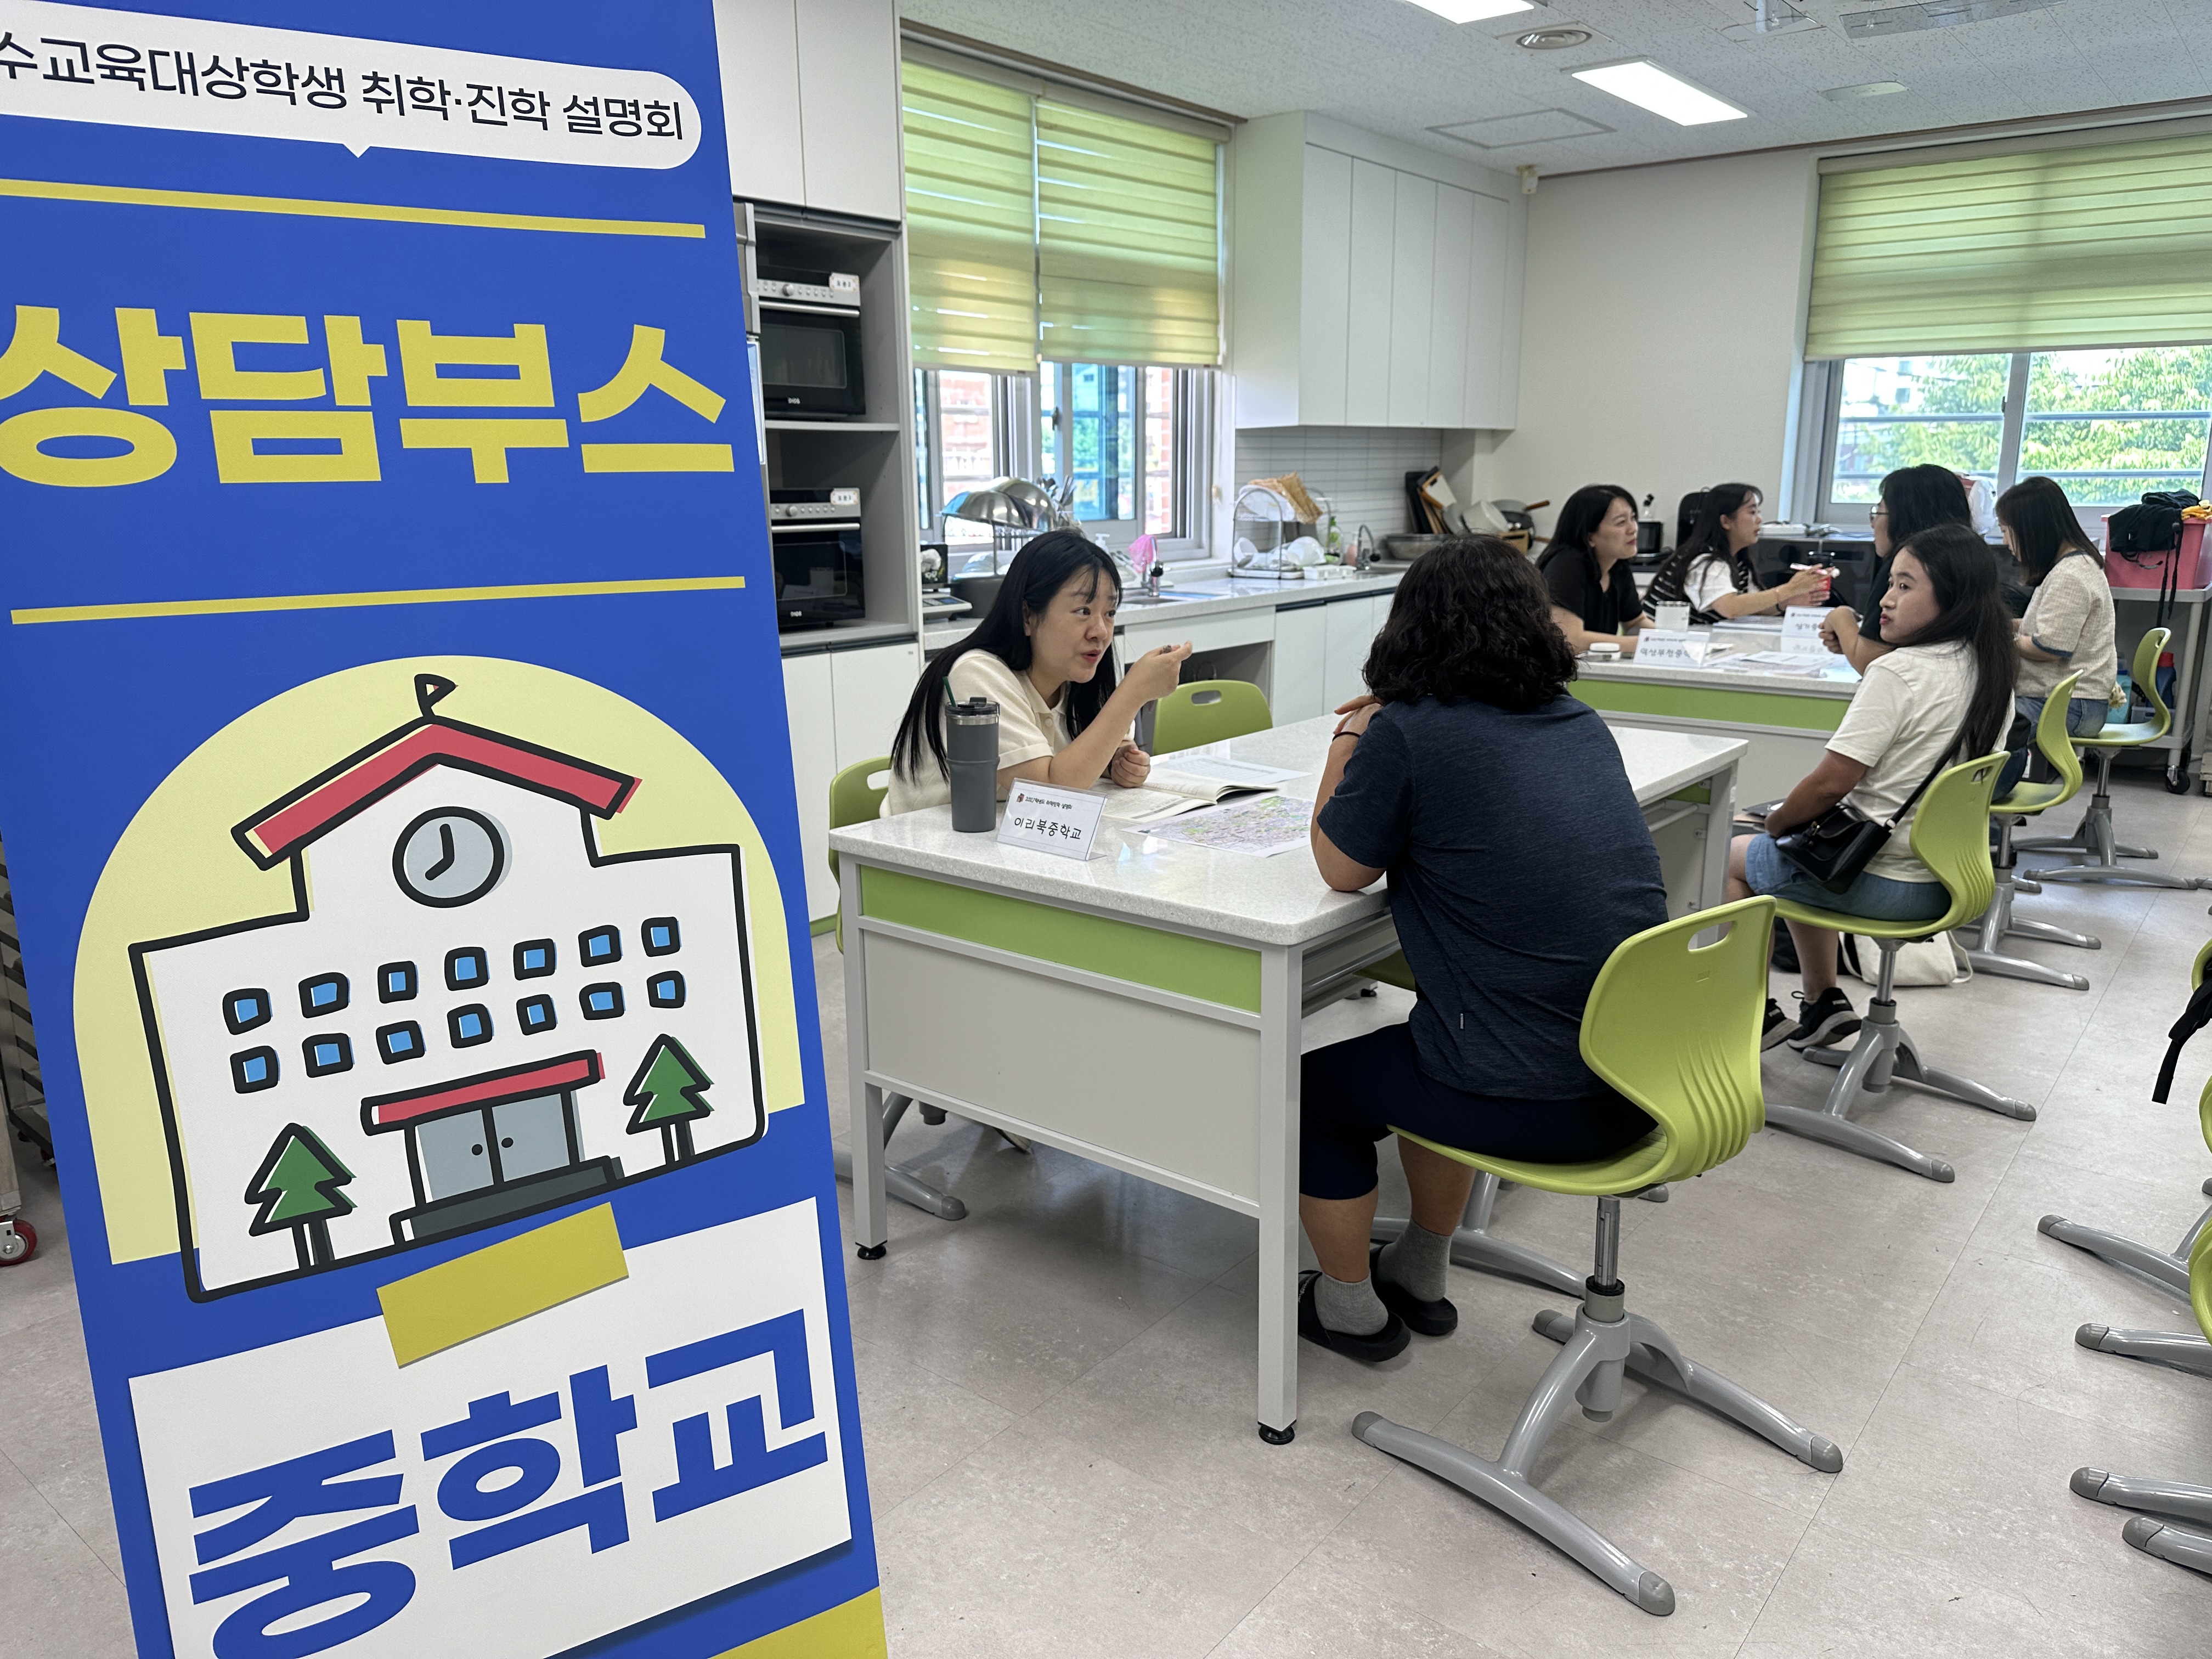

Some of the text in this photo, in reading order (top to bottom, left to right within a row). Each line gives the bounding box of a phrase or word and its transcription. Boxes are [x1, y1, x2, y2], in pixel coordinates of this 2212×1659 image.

[0, 31, 683, 140] 수교육대상학생 취학·진학 설명회
[0, 304, 735, 488] 상담부스
[1014, 817, 1082, 840] 이리북중학교
[188, 1308, 828, 1659] 중학교
